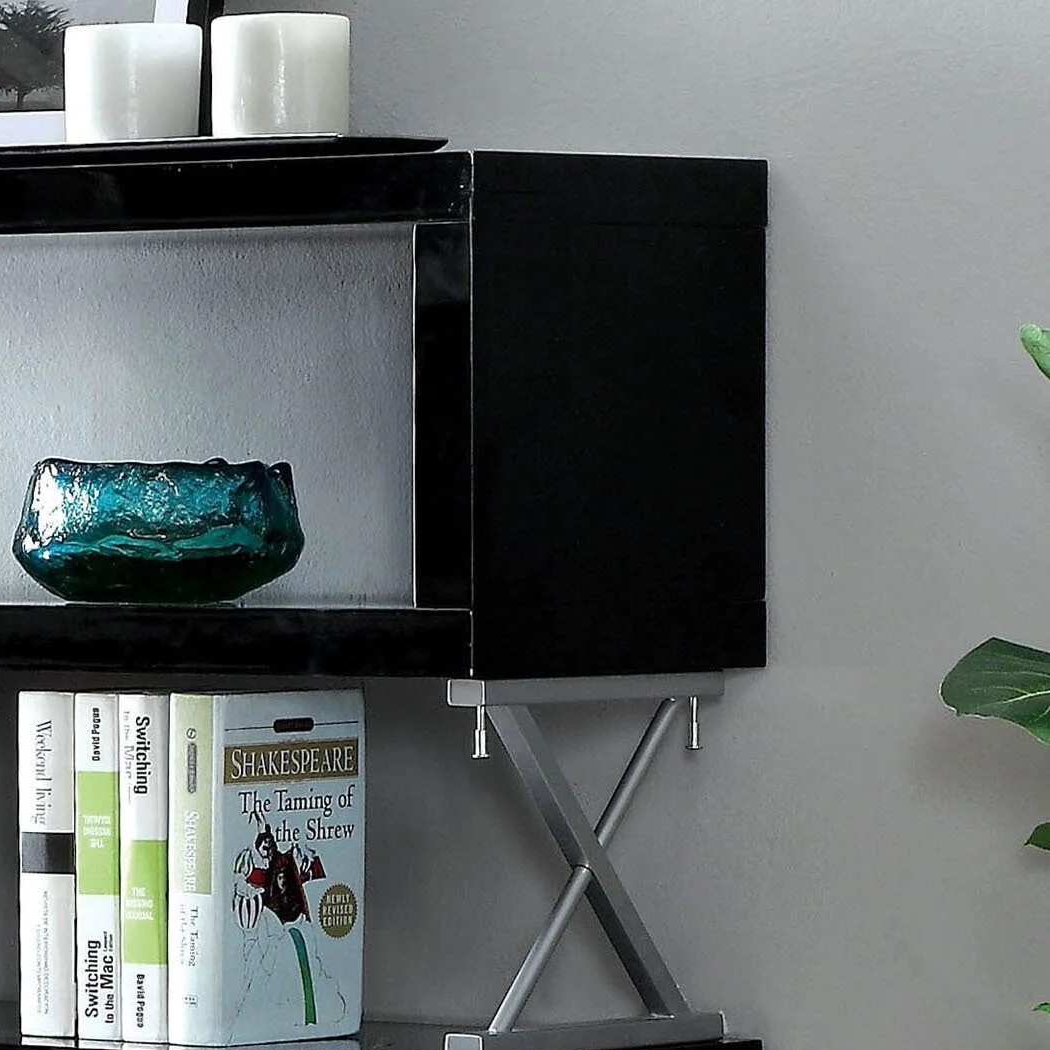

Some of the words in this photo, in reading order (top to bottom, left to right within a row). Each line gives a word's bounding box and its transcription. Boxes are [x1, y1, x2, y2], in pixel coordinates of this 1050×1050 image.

[35, 719, 53, 782] Weekend
[91, 736, 101, 762] David
[134, 716, 151, 795] Switching
[230, 746, 355, 780] SHAKESPEARE
[238, 790, 271, 814] The
[274, 788, 332, 817] Taming
[338, 784, 356, 808] of
[275, 820, 300, 842] the
[306, 818, 355, 841] Shrew
[322, 904, 354, 916] REVISED
[326, 894, 350, 904] NEWLY
[189, 905, 199, 926] The
[322, 915, 353, 927] EDITION
[84, 940, 101, 1018] Switching
[100, 955, 114, 989] Mac
[104, 993, 114, 1010] the
[104, 1013, 114, 1024] to
